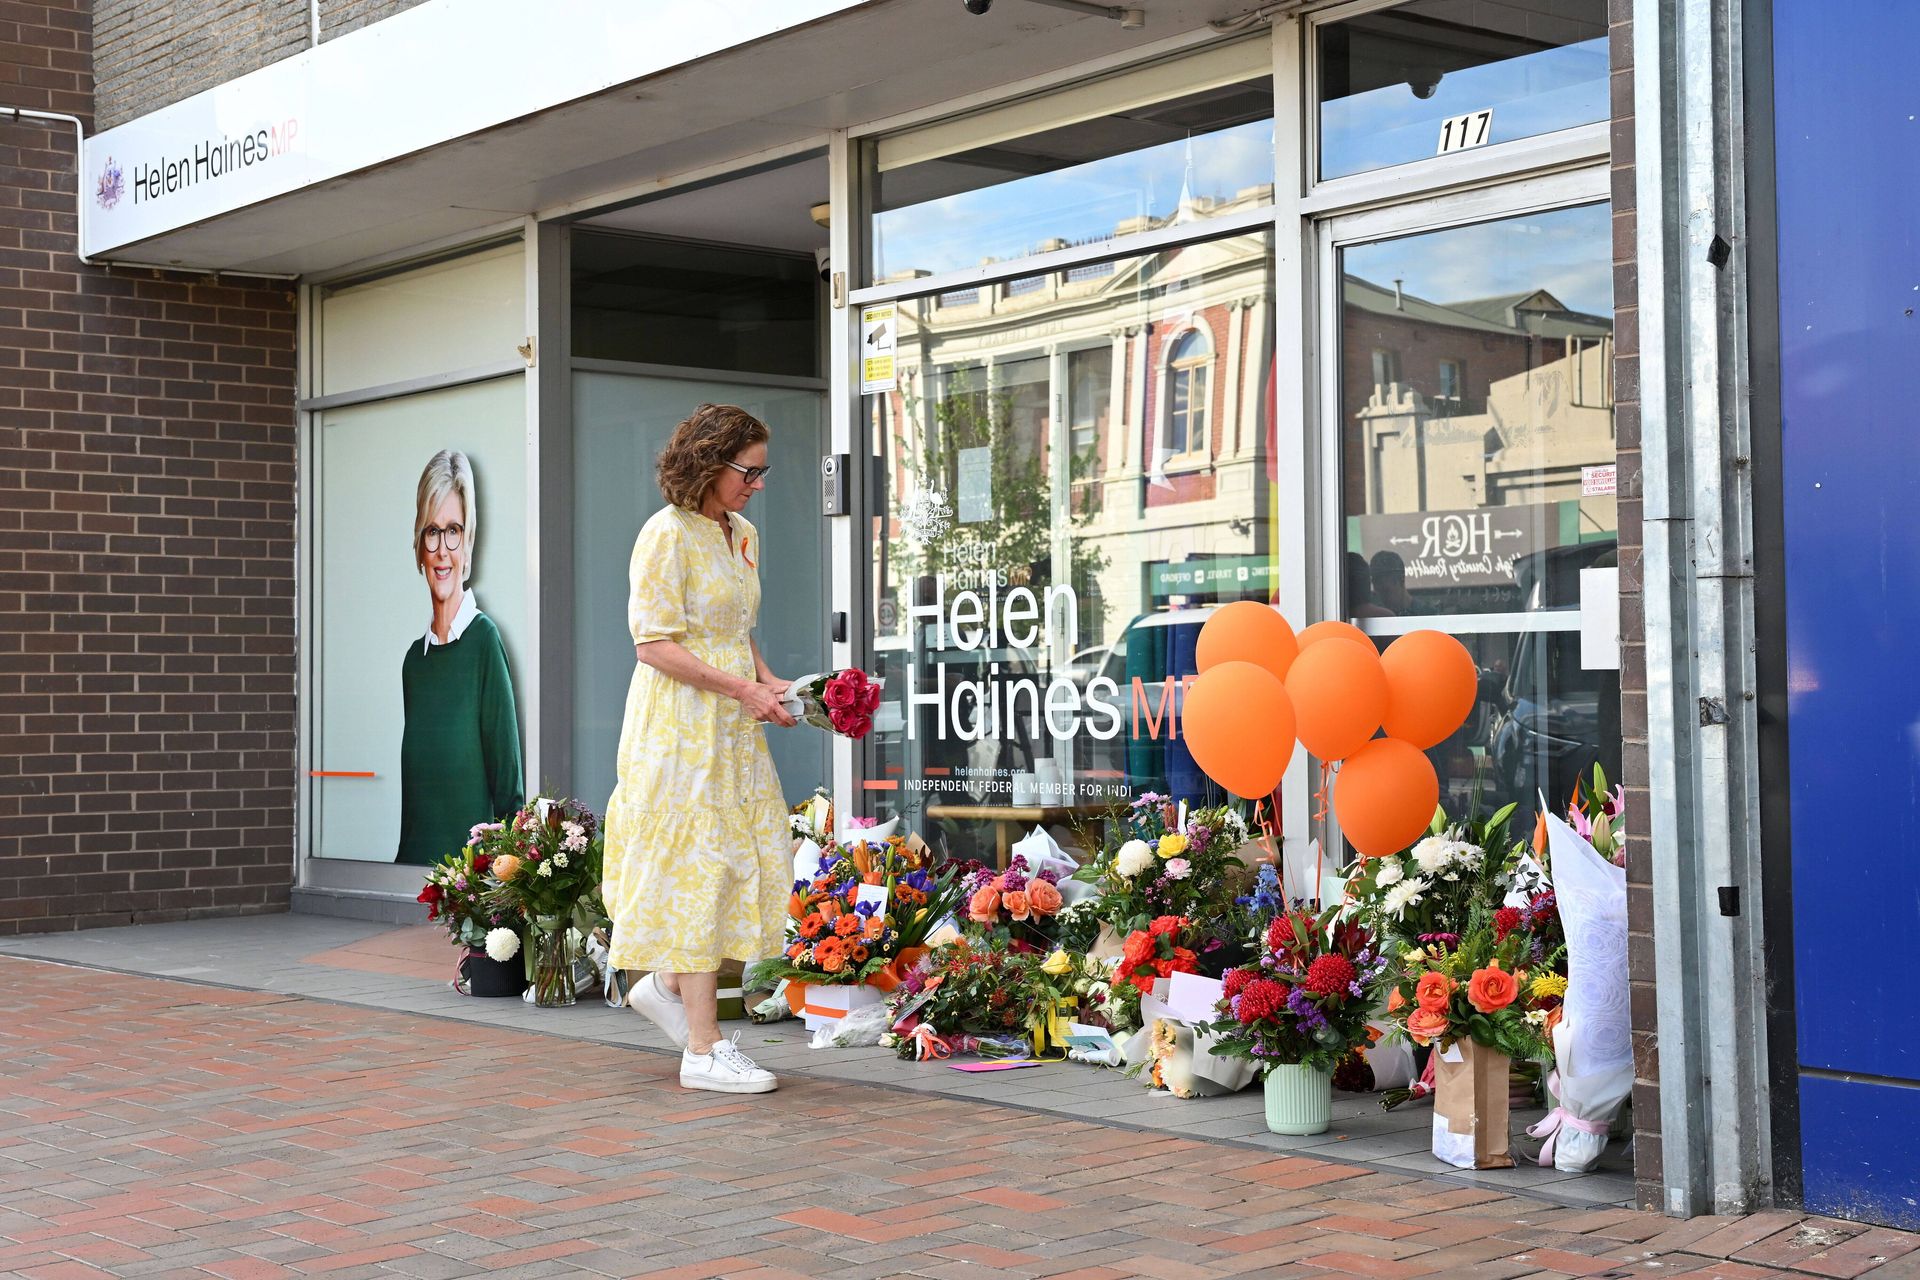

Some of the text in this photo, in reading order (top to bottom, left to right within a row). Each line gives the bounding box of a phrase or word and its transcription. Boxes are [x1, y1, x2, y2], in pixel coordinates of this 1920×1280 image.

[134, 118, 298, 204] Helen Haines MP
[1443, 112, 1490, 151] 117
[943, 538, 996, 564] Helen
[906, 569, 1078, 652] Helen
[906, 662, 1121, 741] Haines
[904, 779, 1132, 797] INDEPENDENT FEDERAL MEMBER FOR INDI
